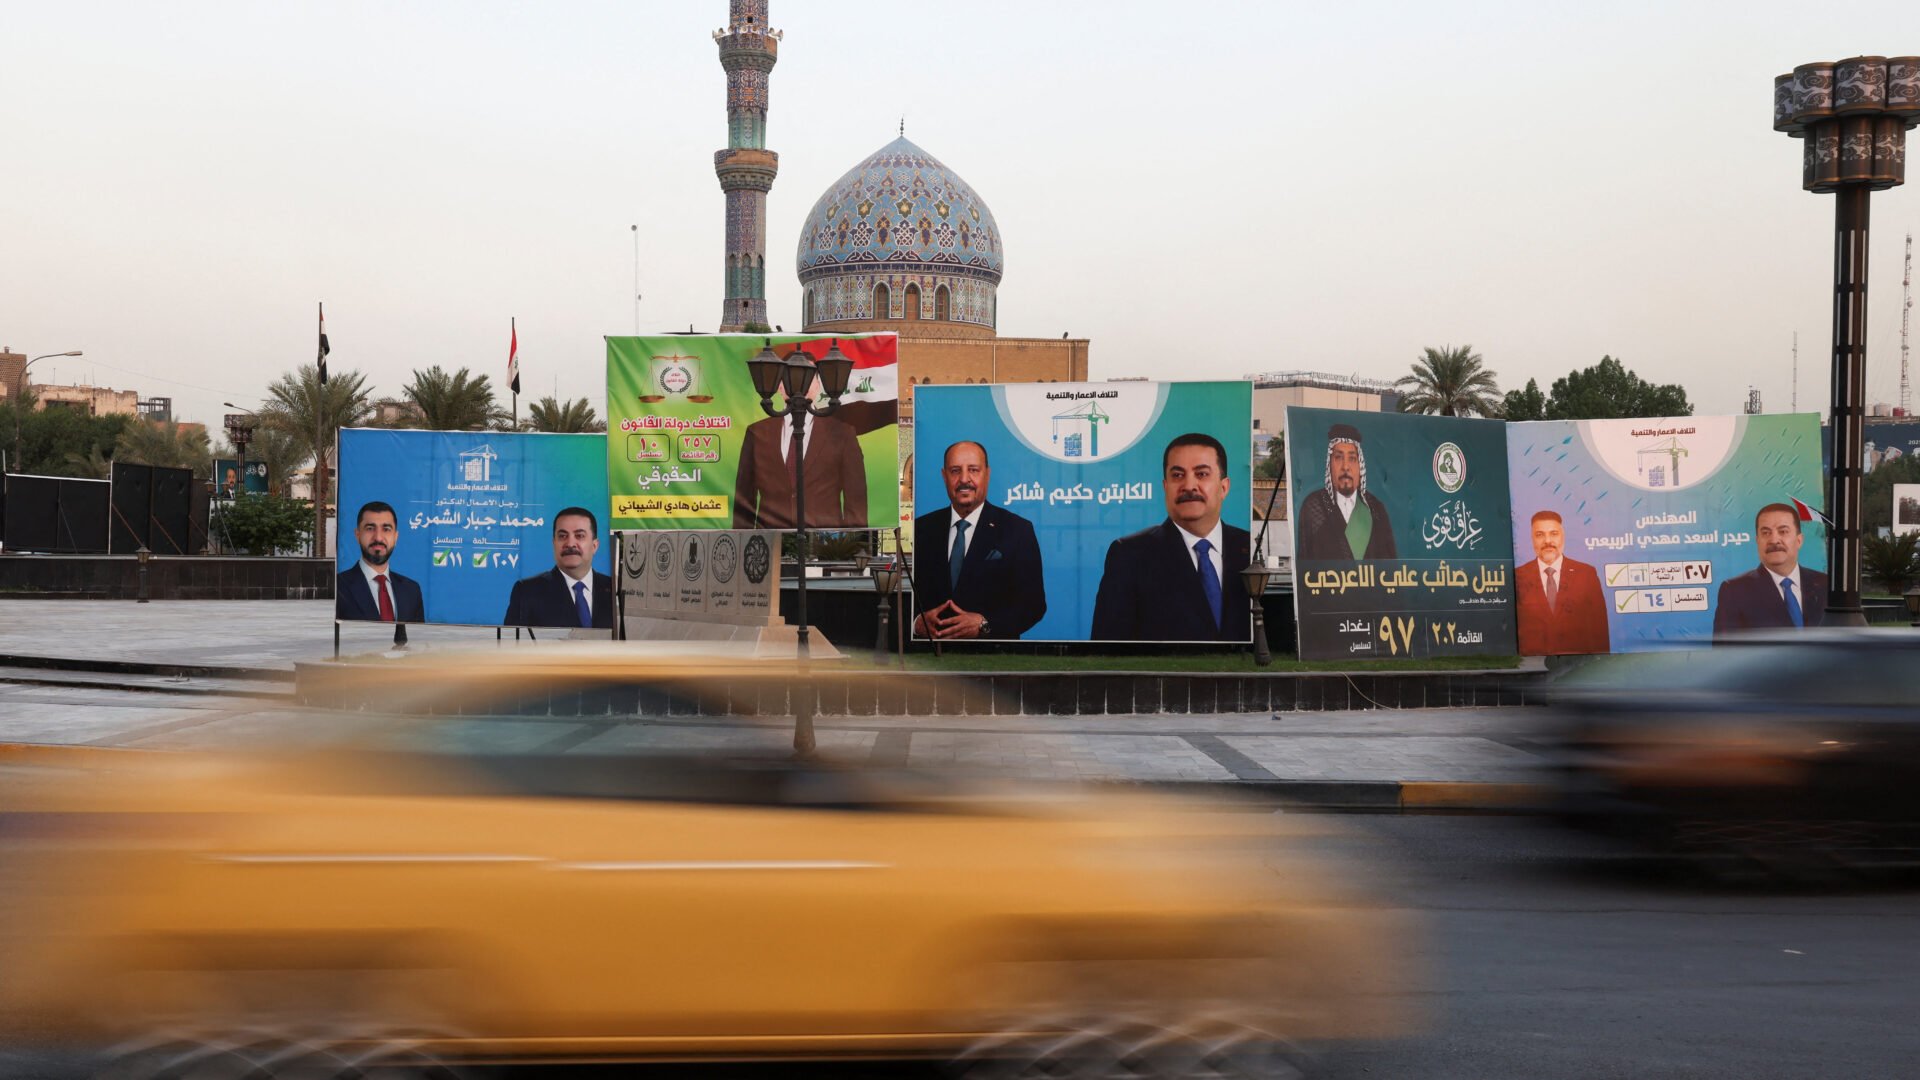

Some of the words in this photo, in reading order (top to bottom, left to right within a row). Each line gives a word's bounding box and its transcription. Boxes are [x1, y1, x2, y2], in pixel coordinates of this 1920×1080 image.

[1046, 391, 1074, 401] والتنمية
[1075, 391, 1097, 400] الاعمار
[621, 415, 662, 432] القانون
[664, 418, 690, 432] دولة
[692, 415, 731, 429] ائتلاف
[1631, 429, 1656, 438] والتنمية
[1657, 428, 1676, 437] الاعمار
[638, 451, 662, 459] تسلسل
[705, 451, 718, 460] رقم
[638, 465, 701, 490] الحقوقي
[1003, 481, 1045, 506] شاكر
[1049, 482, 1093, 506] حكيم
[1098, 482, 1153, 505] الكابتن
[435, 498, 466, 506] الدكتور
[466, 499, 497, 507] الاعمال
[498, 499, 519, 508] رجل
[618, 499, 662, 515] الشيباني
[664, 501, 690, 514] هادي
[691, 500, 722, 512] عثمان
[409, 508, 461, 530] الشمري
[462, 511, 497, 530] جبار
[500, 514, 545, 527] محمد
[1636, 510, 1697, 529] المهندس
[433, 537, 463, 545] التسلسل
[1584, 533, 1633, 550] الربيعي
[1637, 533, 1681, 550] مهدي
[1684, 530, 1718, 544] اسعد
[1721, 531, 1750, 547] حيدر
[449, 551, 463, 568] ١١
[492, 552, 519, 568] ٢٠٧
[1304, 564, 1375, 595] الاعرجي
[1379, 564, 1419, 594] علي
[1422, 560, 1469, 593] صائب
[1472, 563, 1506, 594] نبيل
[1684, 563, 1710, 580] ٢٠٧
[1644, 592, 1665, 607] ٦٤
[1674, 594, 1705, 604] التسلسل
[1339, 619, 1371, 635] بغداد
[1431, 621, 1456, 646] ٢٠٢
[1379, 615, 1415, 656] ٩٧
[1457, 630, 1483, 645] القائمة
[1350, 641, 1371, 653] تسلسل
